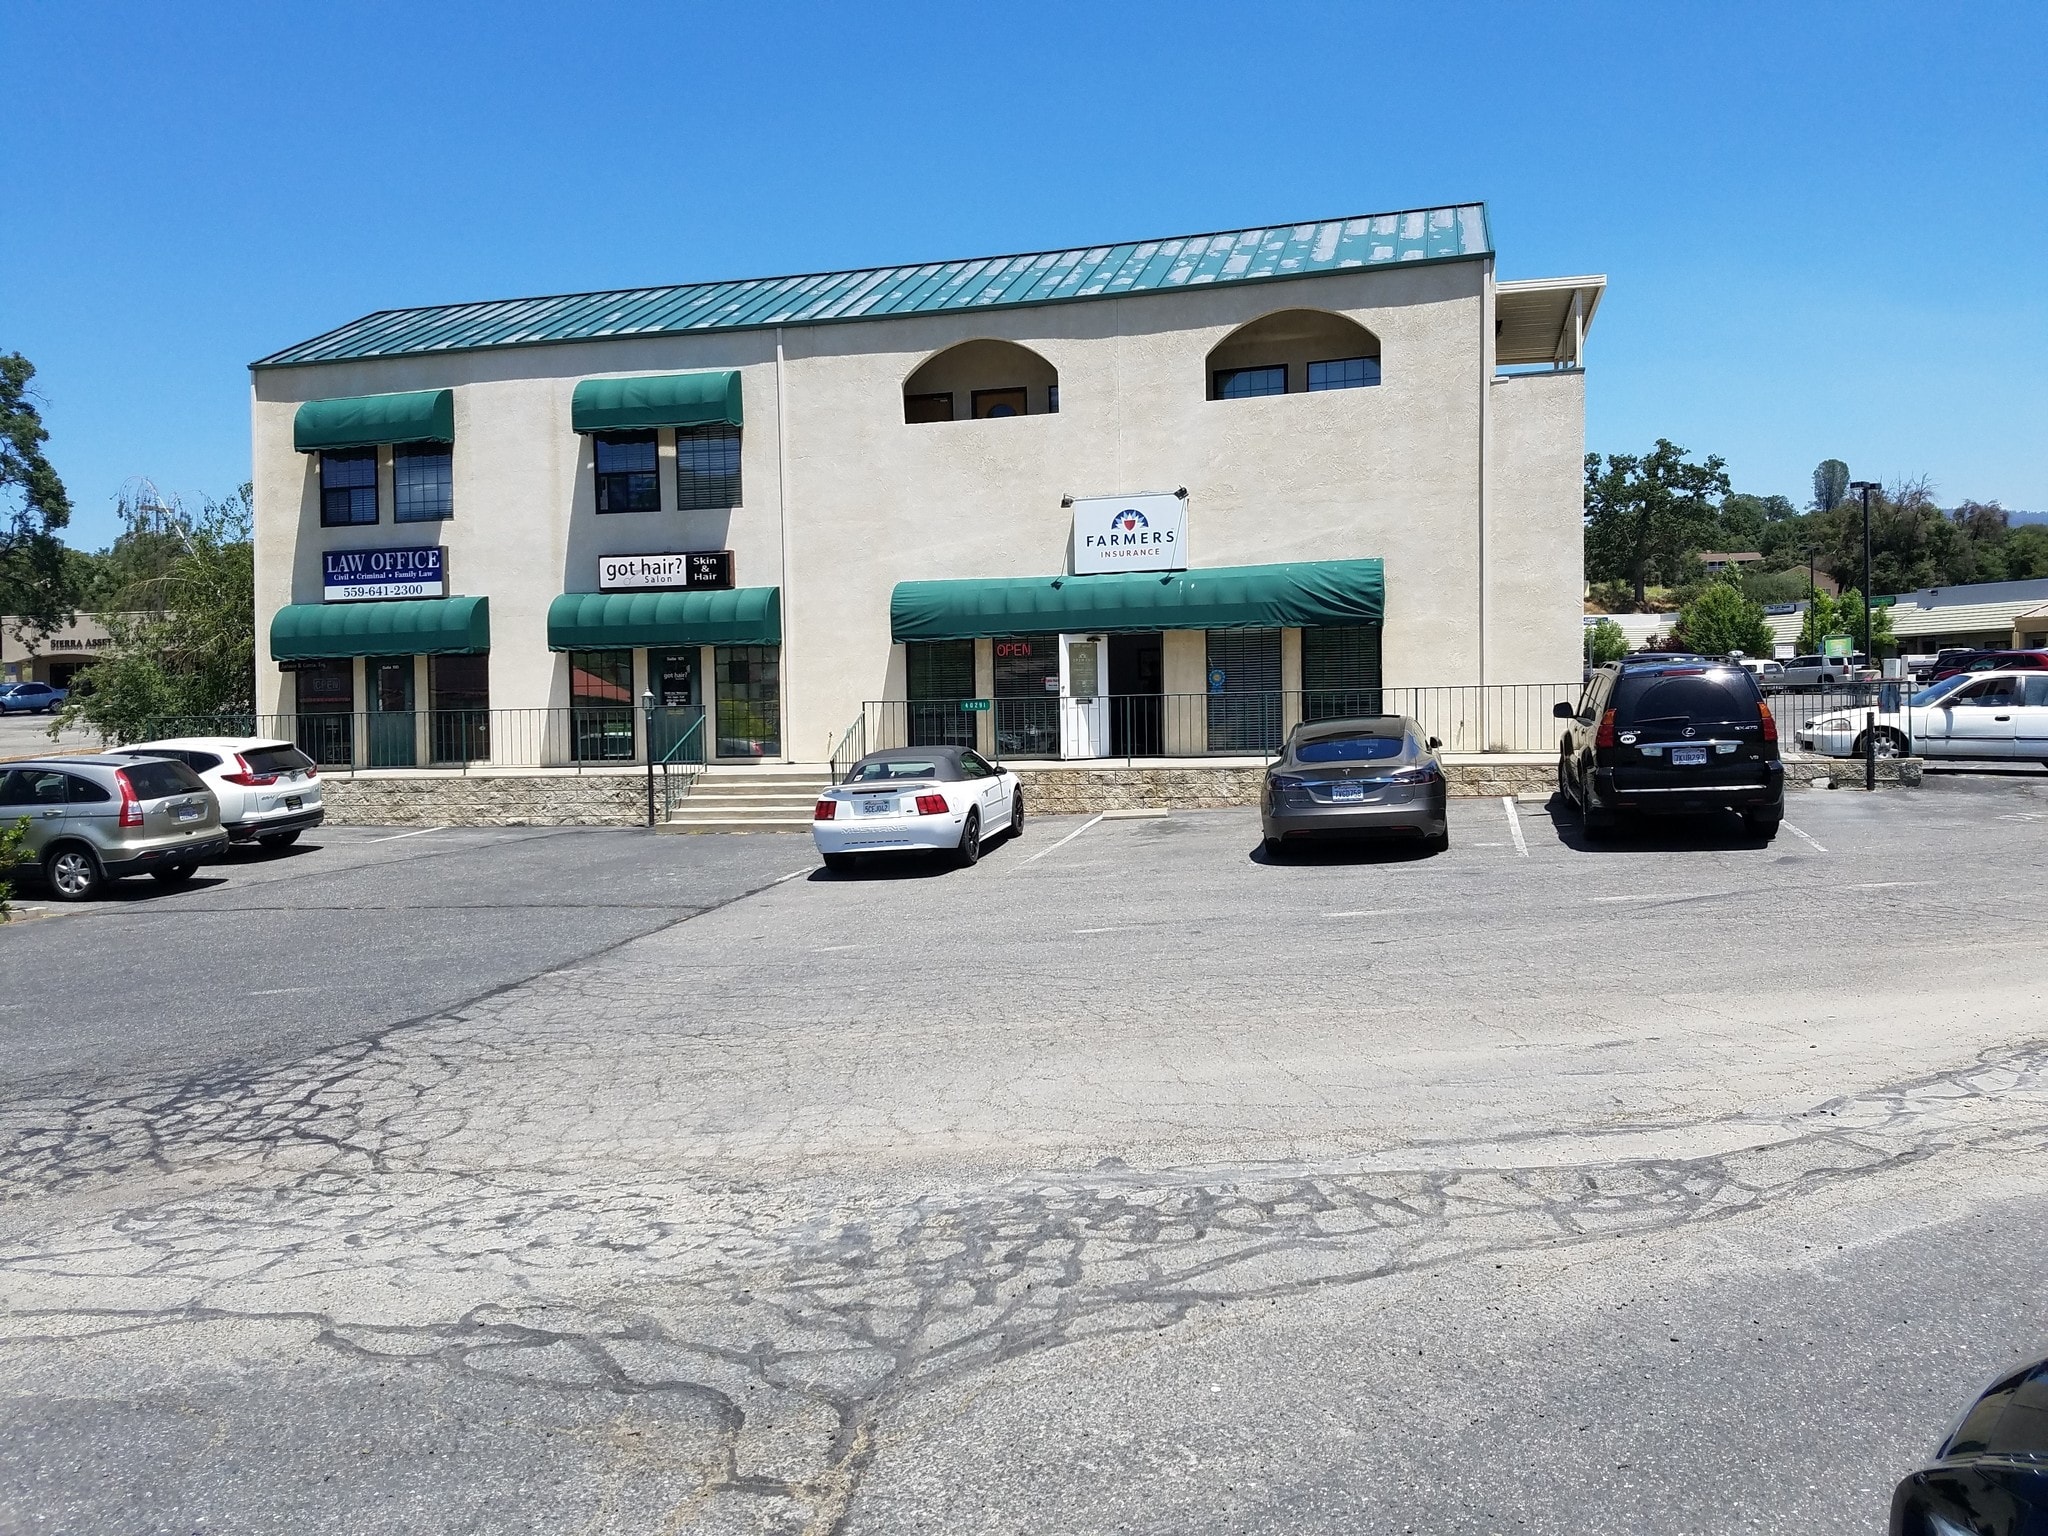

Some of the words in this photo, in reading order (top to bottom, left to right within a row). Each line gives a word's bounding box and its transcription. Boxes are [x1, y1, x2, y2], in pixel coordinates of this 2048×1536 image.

[1086, 531, 1175, 547] FARMERS
[1101, 548, 1160, 558] INSURANCE
[327, 554, 365, 573] LAW
[371, 550, 440, 571] OFFICE
[693, 556, 717, 565] Skin
[606, 562, 636, 581] got
[641, 557, 683, 576] hair?
[701, 565, 710, 573] &
[333, 573, 349, 581] Civil
[356, 572, 386, 580] Criminal
[394, 571, 417, 580] Family
[644, 575, 673, 584] Salon
[694, 572, 717, 581] Hair
[343, 585, 423, 598] 559-641-2300
[50, 639, 82, 649] SIERRA
[996, 644, 1032, 656] OPEN
[315, 680, 339, 690] OPEN
[841, 825, 909, 835] MUSTANG
